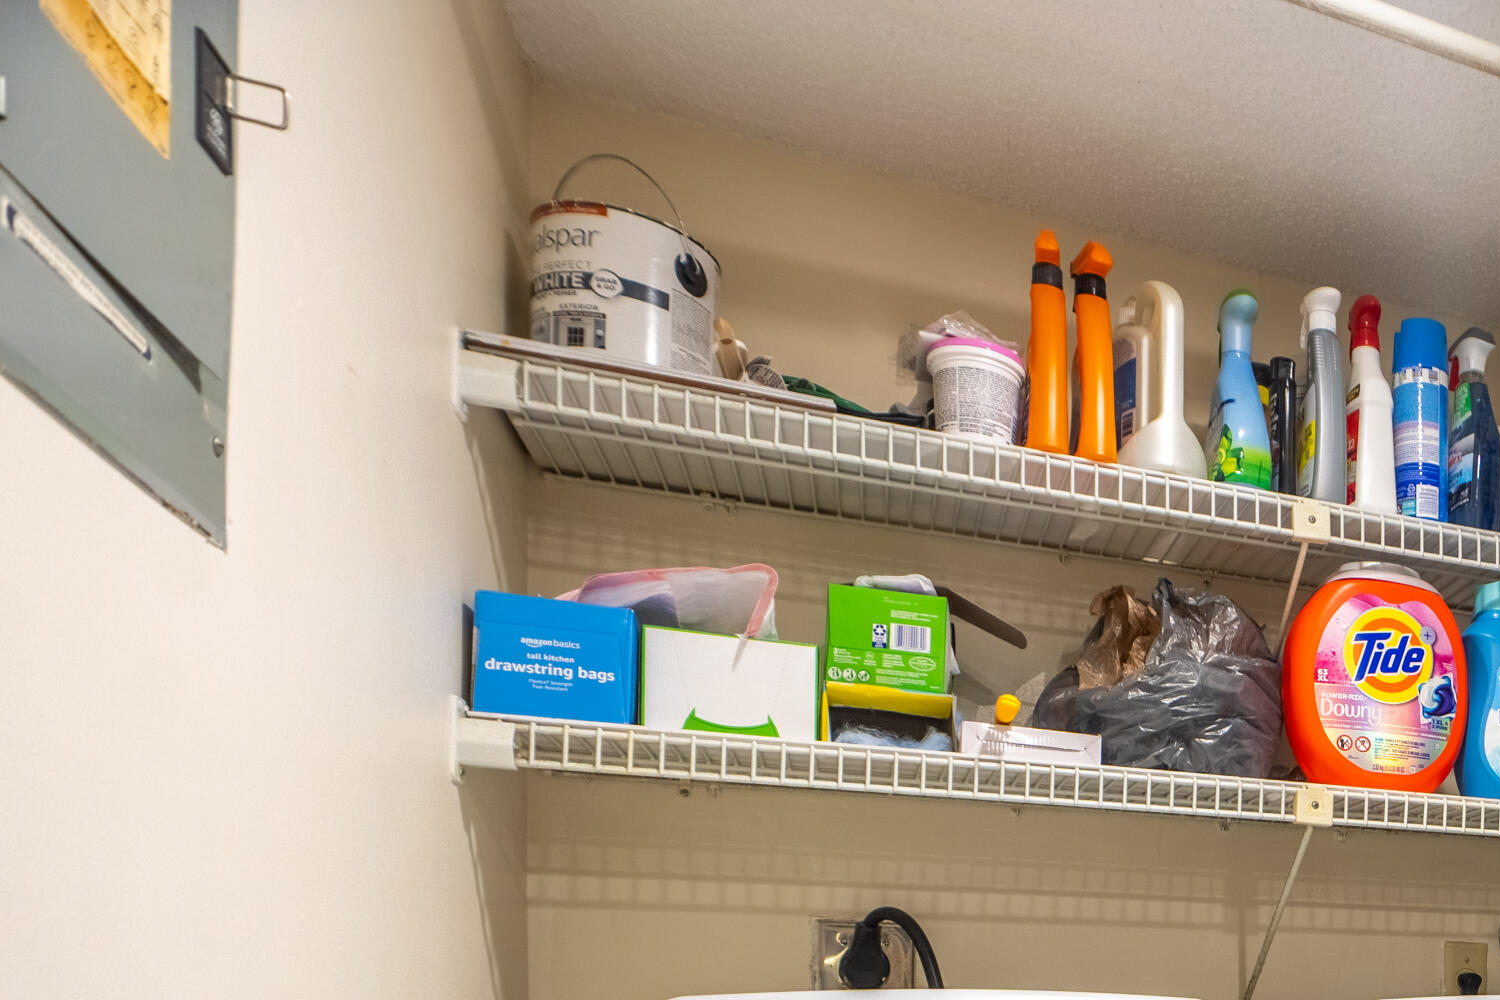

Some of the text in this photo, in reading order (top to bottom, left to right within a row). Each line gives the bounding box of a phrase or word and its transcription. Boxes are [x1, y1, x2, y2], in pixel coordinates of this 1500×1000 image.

[533, 224, 598, 253] alspar
[534, 271, 585, 290] WHITE
[484, 657, 616, 684] drawstring bags
[526, 652, 575, 664] tall kitchen
[1352, 630, 1426, 684] Tide
[1320, 697, 1383, 726] Downy
